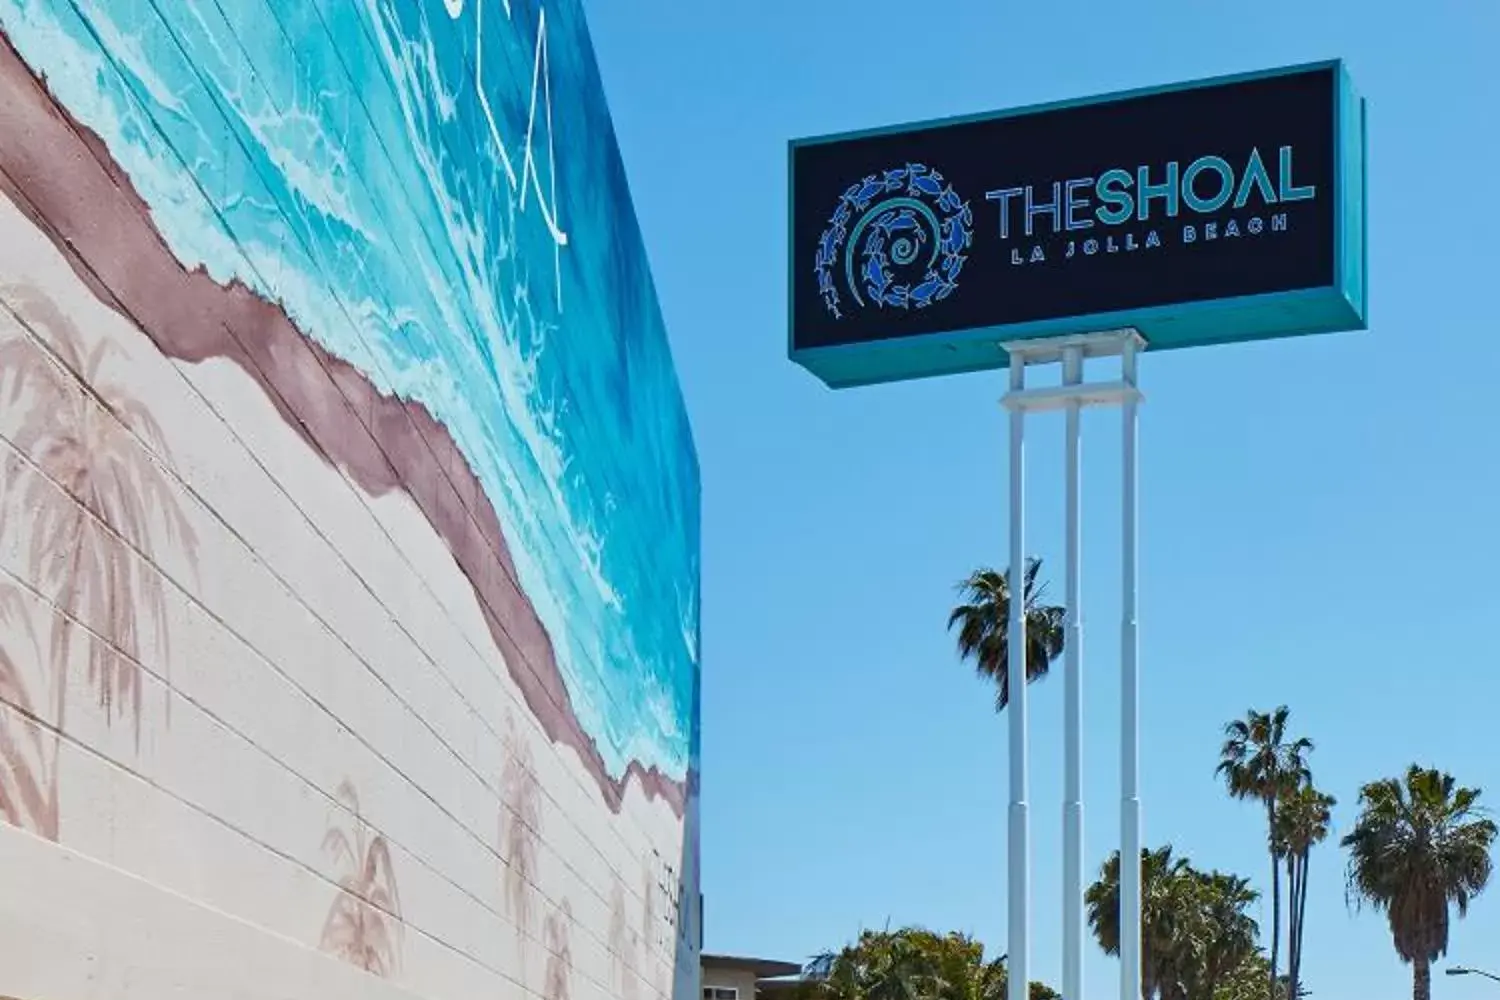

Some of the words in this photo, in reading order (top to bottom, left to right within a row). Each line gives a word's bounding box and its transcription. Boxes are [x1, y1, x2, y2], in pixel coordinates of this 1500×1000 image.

[1011, 245, 1046, 265] LA
[1065, 231, 1162, 257] JOLLA
[1183, 213, 1288, 243] BEACH
